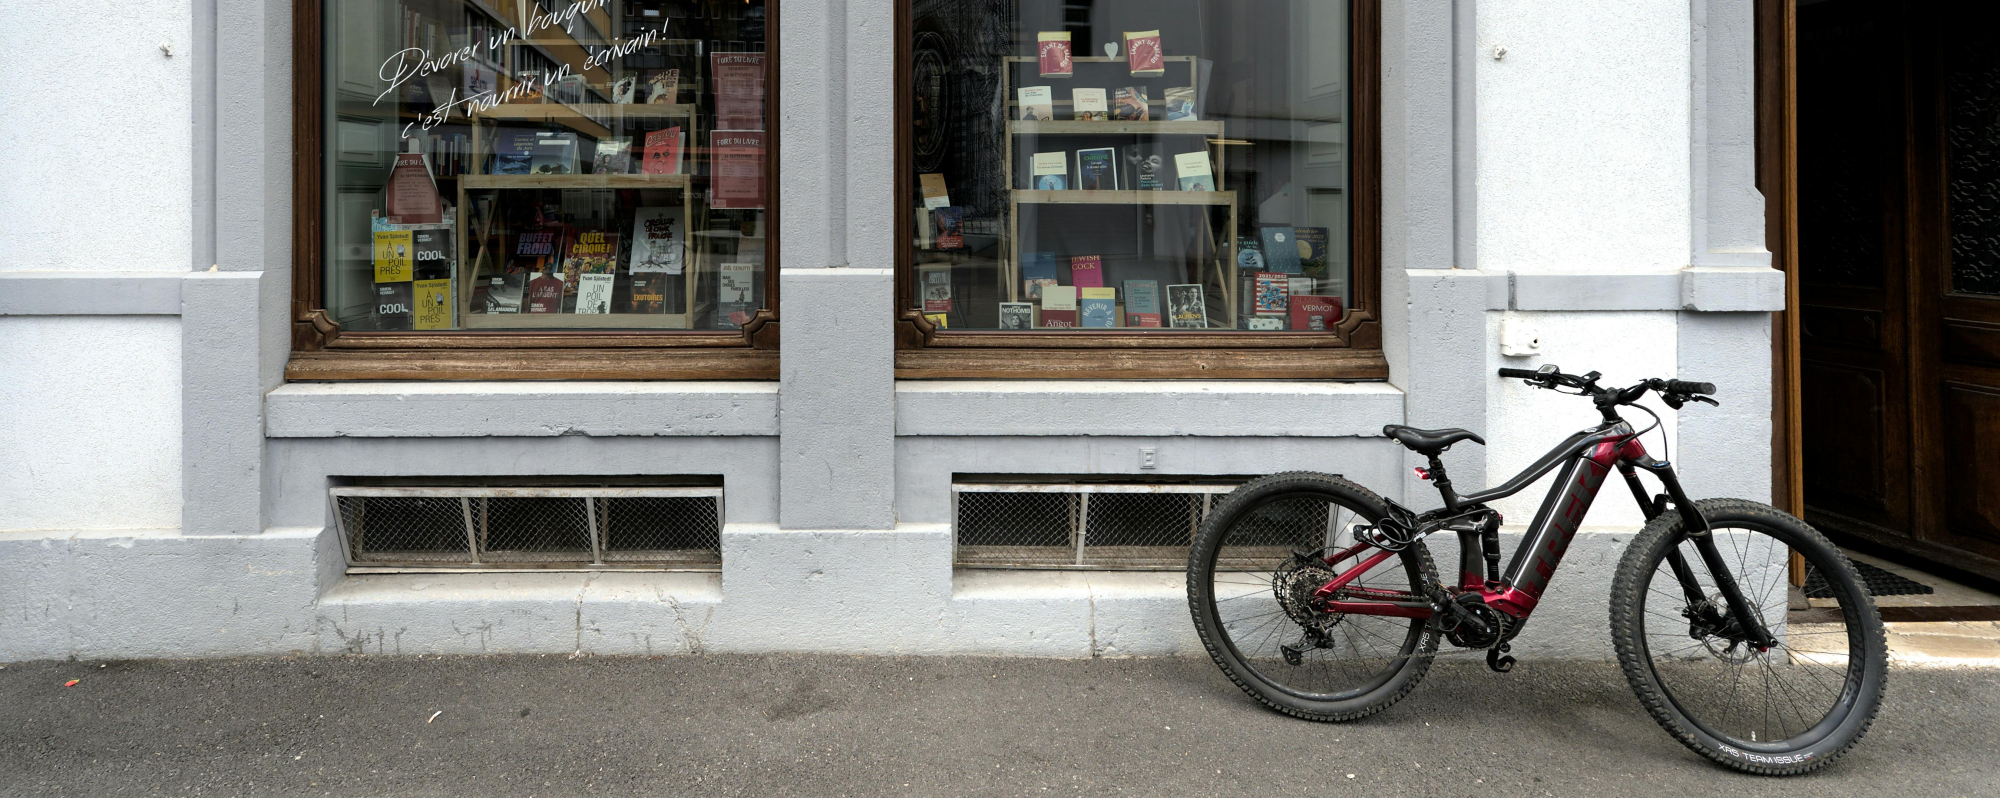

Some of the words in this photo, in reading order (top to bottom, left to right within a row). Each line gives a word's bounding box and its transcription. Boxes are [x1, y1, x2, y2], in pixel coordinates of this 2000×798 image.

[716, 56, 732, 64] FOIRE
[742, 56, 760, 64] LIVRE
[372, 40, 481, 107] Dévorer
[489, 27, 515, 50] un
[402, 87, 492, 140] c'est
[467, 77, 536, 117] nourrir
[544, 63, 570, 86] un
[717, 138, 732, 146] FOIRE
[742, 138, 759, 146] LIVRE
[520, 233, 554, 242] BUFFET
[580, 232, 605, 244] QUEL
[387, 241, 392, 250] À
[516, 242, 553, 255] FROID
[382, 251, 394, 259] UN
[417, 250, 446, 260] COOL
[1072, 255, 1100, 263] JEWISH
[388, 258, 406, 266] POIL
[380, 264, 401, 274] PRÈS
[592, 284, 604, 292] UN
[426, 290, 432, 299] À
[586, 292, 602, 300] POIL
[380, 303, 409, 314] COOL
[422, 300, 433, 308] UN
[587, 300, 598, 308] DE
[427, 306, 445, 315] POIL
[1083, 303, 1108, 316] REVENIR
[420, 314, 440, 323] PRÈS
[1046, 319, 1072, 327] Angot
[1523, 461, 1609, 599] TREK
[1741, 752, 1773, 764] TEAM
[1774, 754, 1804, 764] ISSUE
